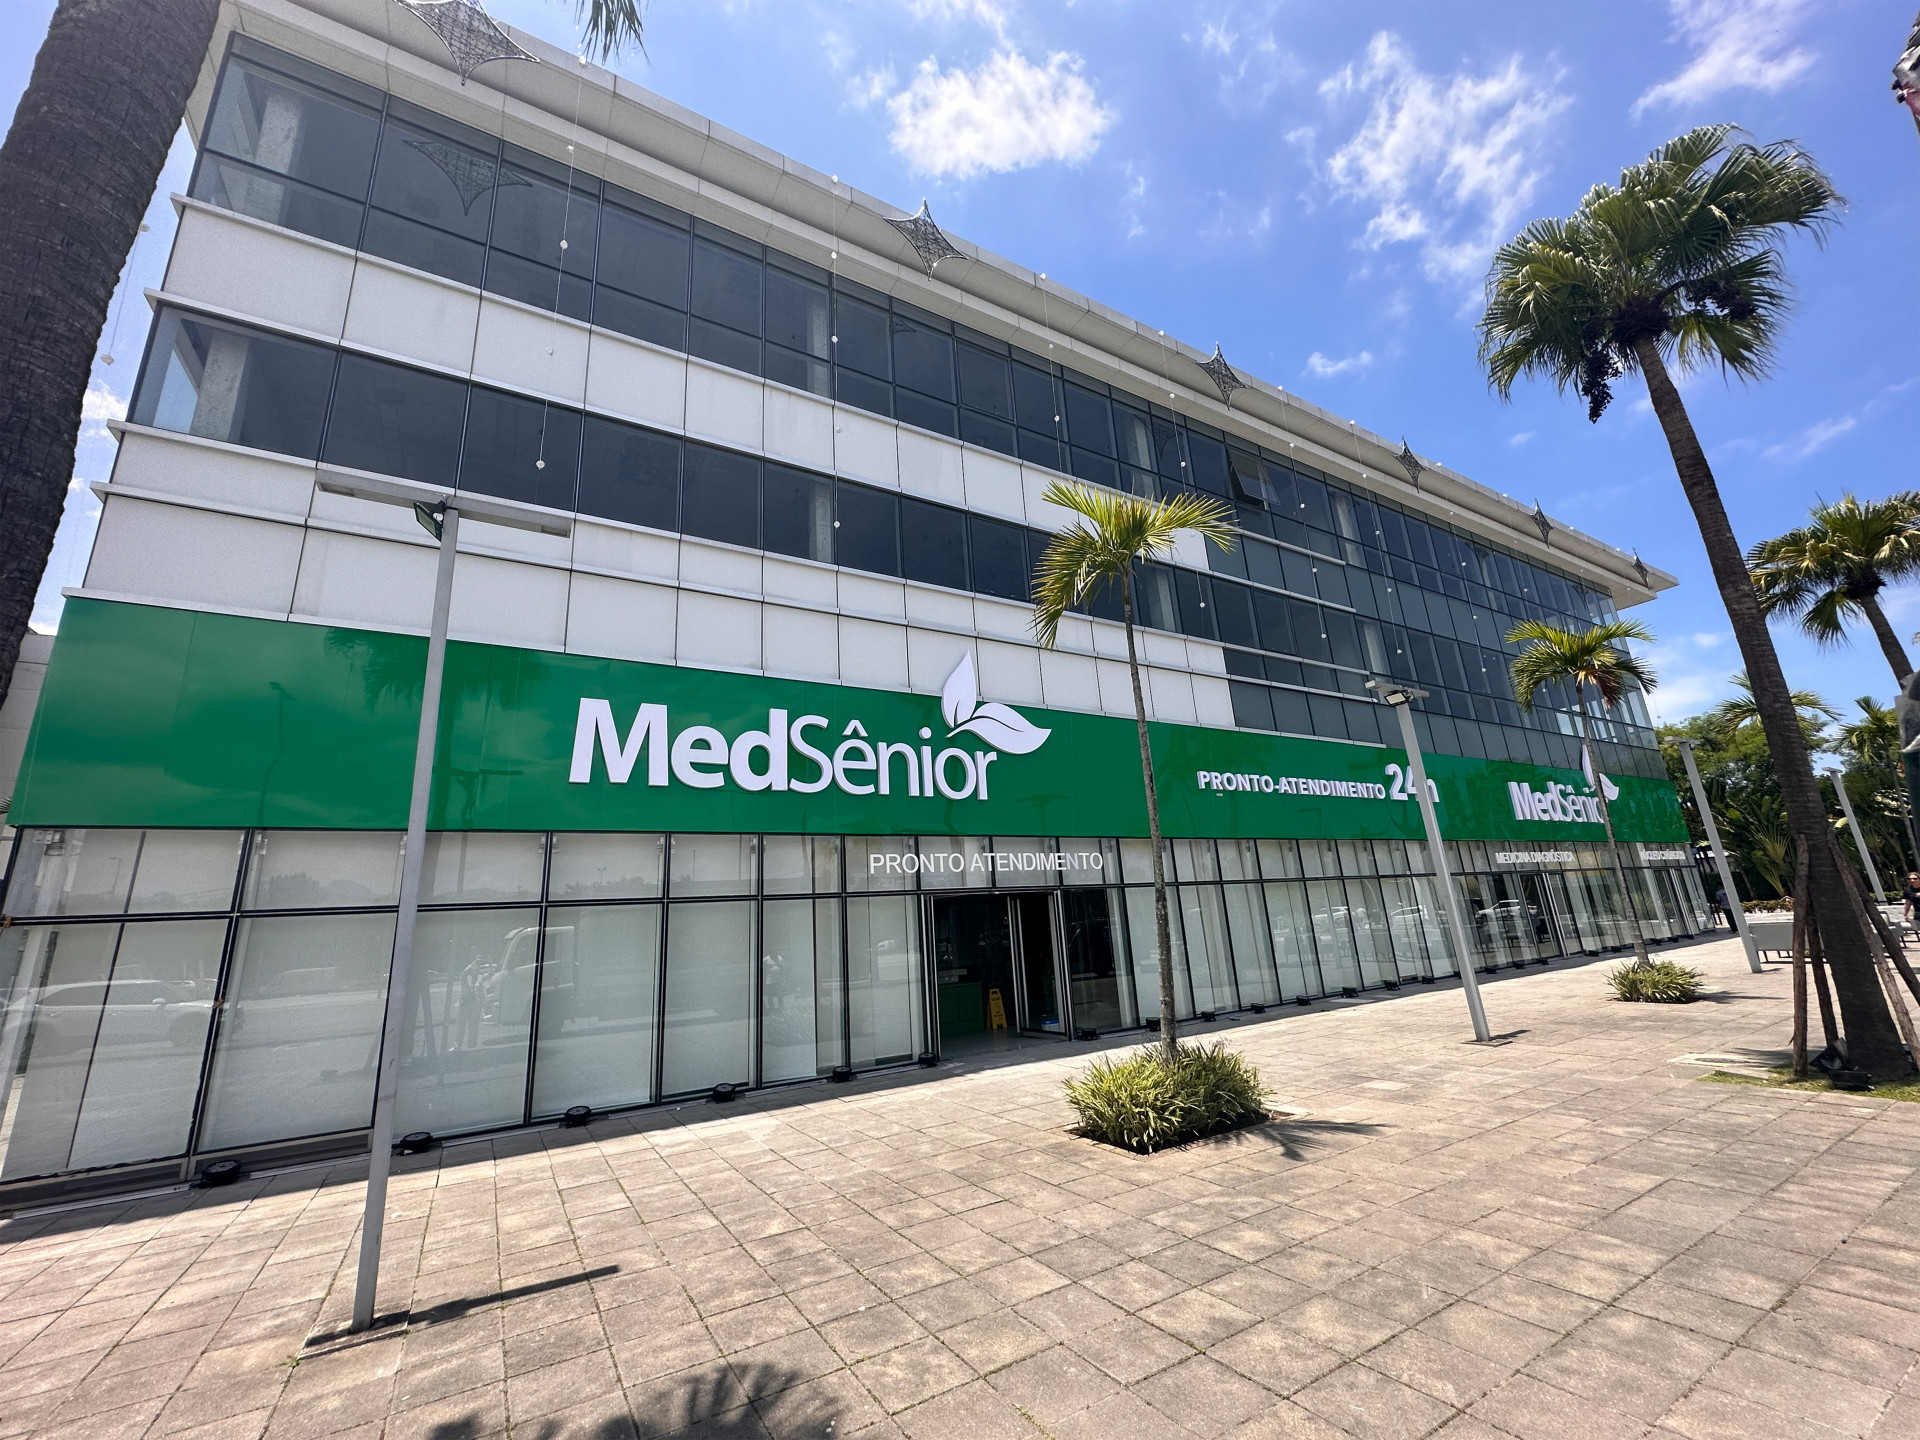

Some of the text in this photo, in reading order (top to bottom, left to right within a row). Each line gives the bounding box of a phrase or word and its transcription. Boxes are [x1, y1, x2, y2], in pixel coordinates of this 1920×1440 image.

[569, 697, 997, 801] MedSênior
[1197, 770, 1386, 799] PRONTO-ATENDIMENTO
[869, 852, 1103, 874] PRONTO ATENDIMENTO
